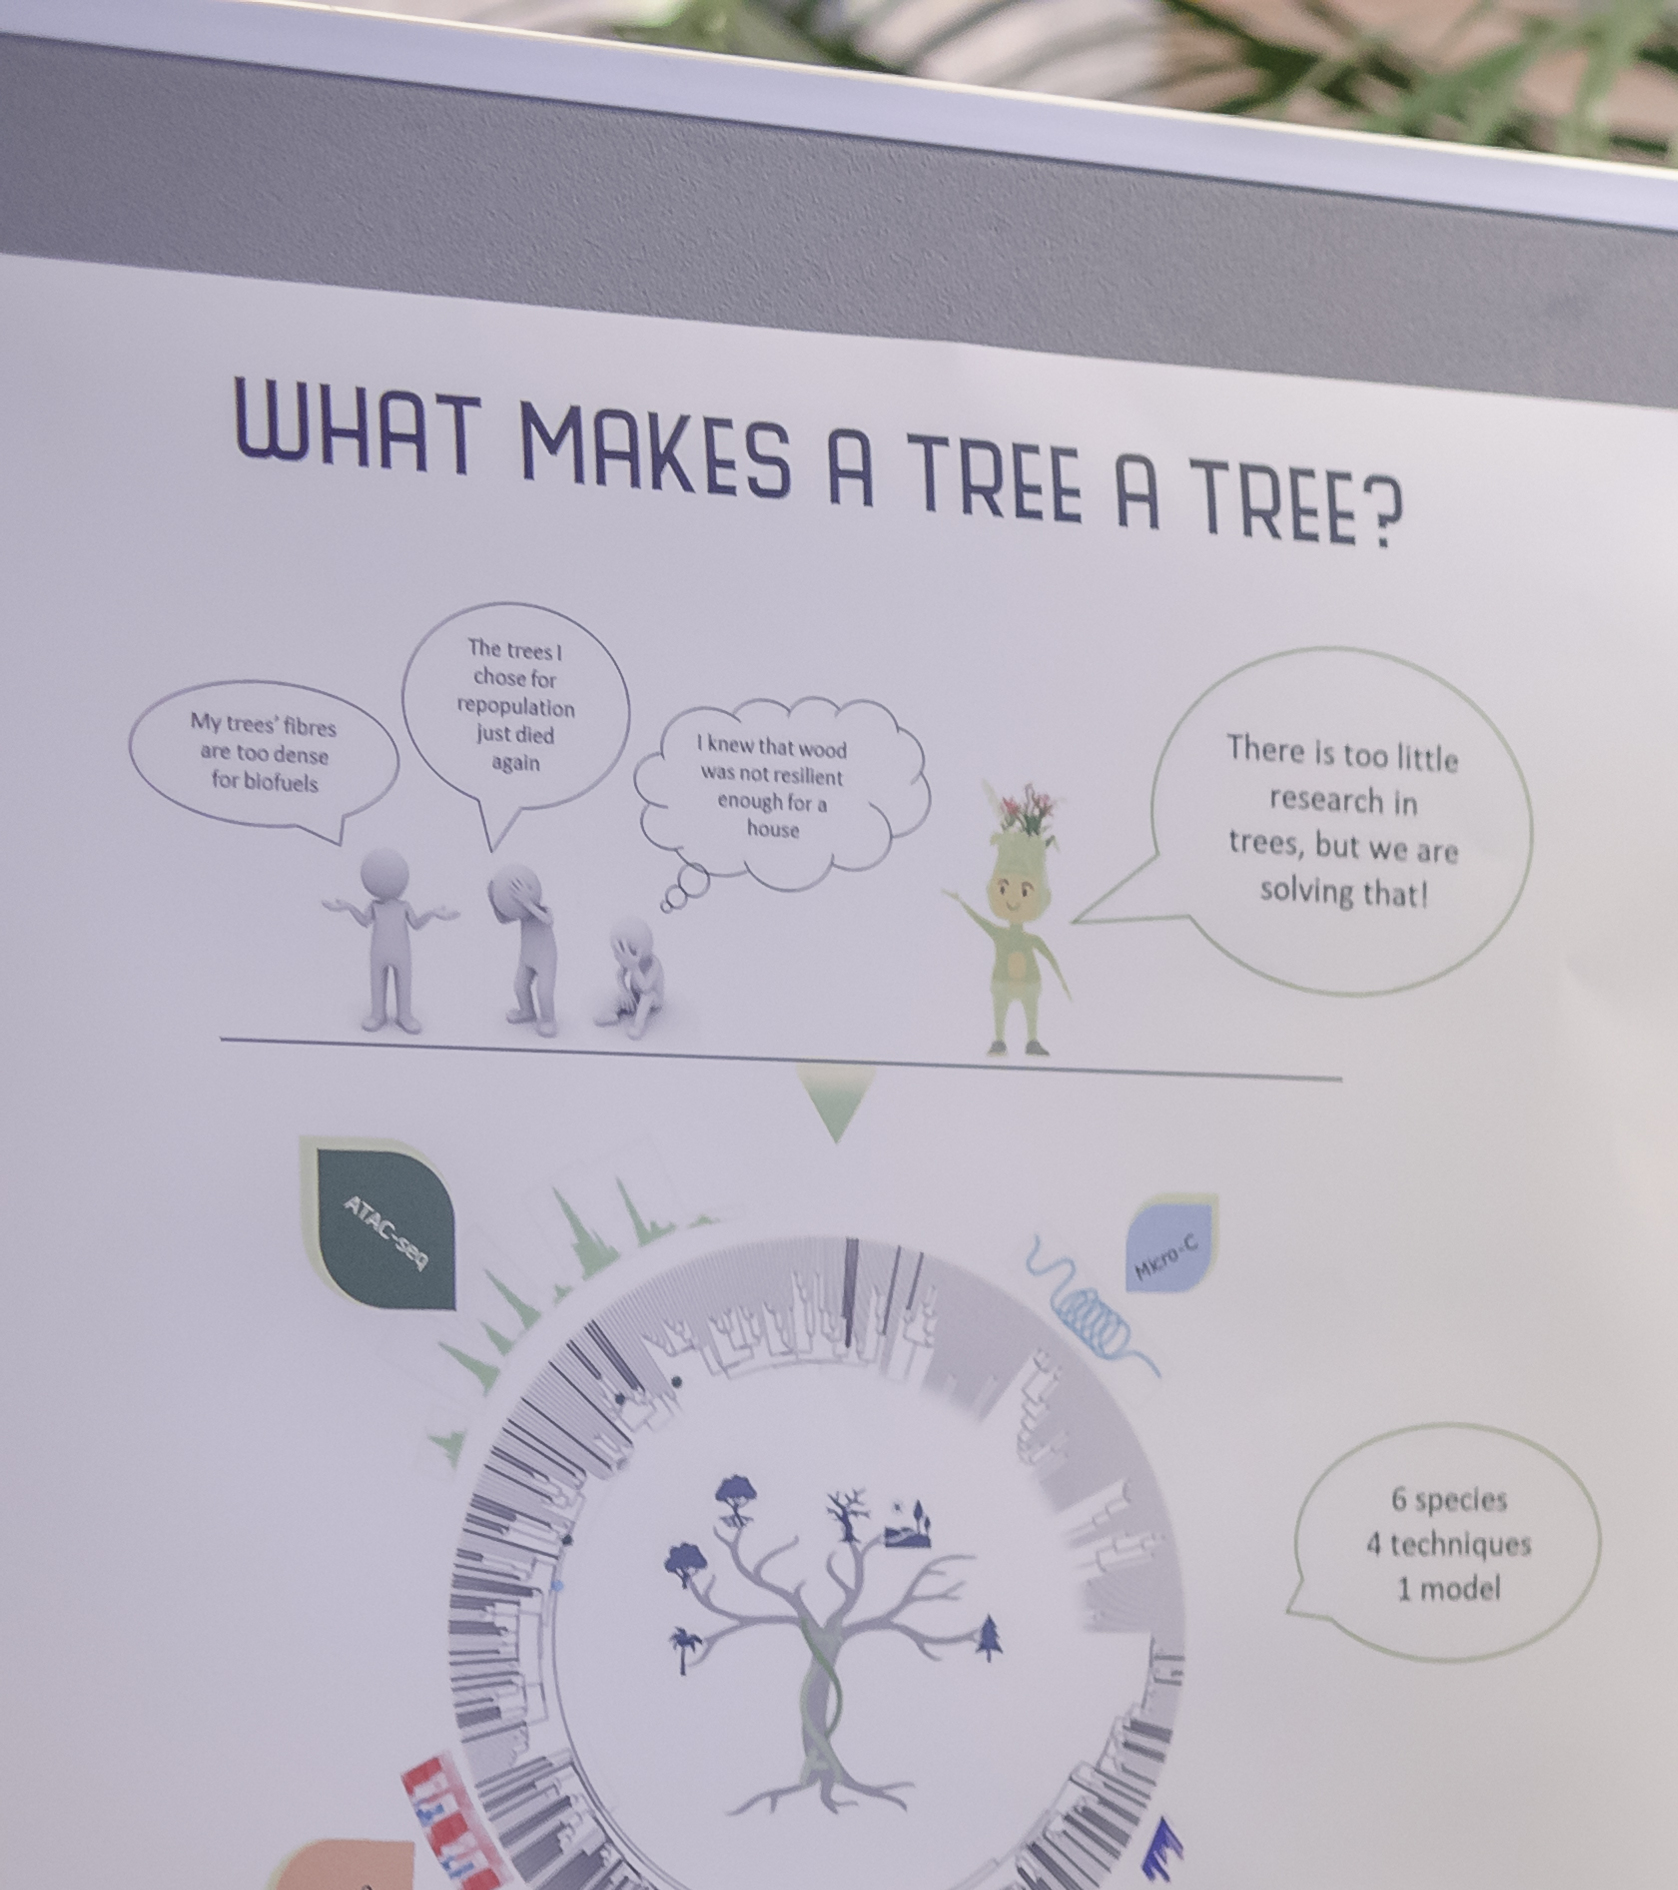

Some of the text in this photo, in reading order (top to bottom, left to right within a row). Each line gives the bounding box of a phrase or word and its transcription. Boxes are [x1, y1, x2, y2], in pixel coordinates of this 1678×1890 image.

[235, 377, 1403, 548] WHAT MAKES A TREE A TREE?
[468, 638, 501, 657] The
[508, 643, 553, 660] trees
[474, 666, 556, 688] chose for
[458, 697, 575, 718] repopulation
[191, 712, 221, 734] My
[284, 716, 337, 737] fibres
[477, 723, 554, 744] just died
[201, 745, 329, 765] are too dense
[698, 734, 847, 759] I knew that wood
[1227, 733, 1458, 773] There is too little
[492, 754, 540, 774] again
[701, 766, 843, 786] was not resilient
[212, 769, 319, 793] for biofuels
[718, 792, 827, 814] enough for a
[1271, 786, 1417, 816] research in
[747, 818, 799, 838] house
[1230, 829, 1458, 864] trees, but we are
[1261, 874, 1427, 911] solving that!
[343, 1194, 429, 1272] ATAC-seq
[1133, 1231, 1200, 1282] Micro-C
[1392, 1486, 1507, 1517] 6 species
[1367, 1529, 1531, 1562] 4 techniques
[1400, 1574, 1500, 1601] 1 model
